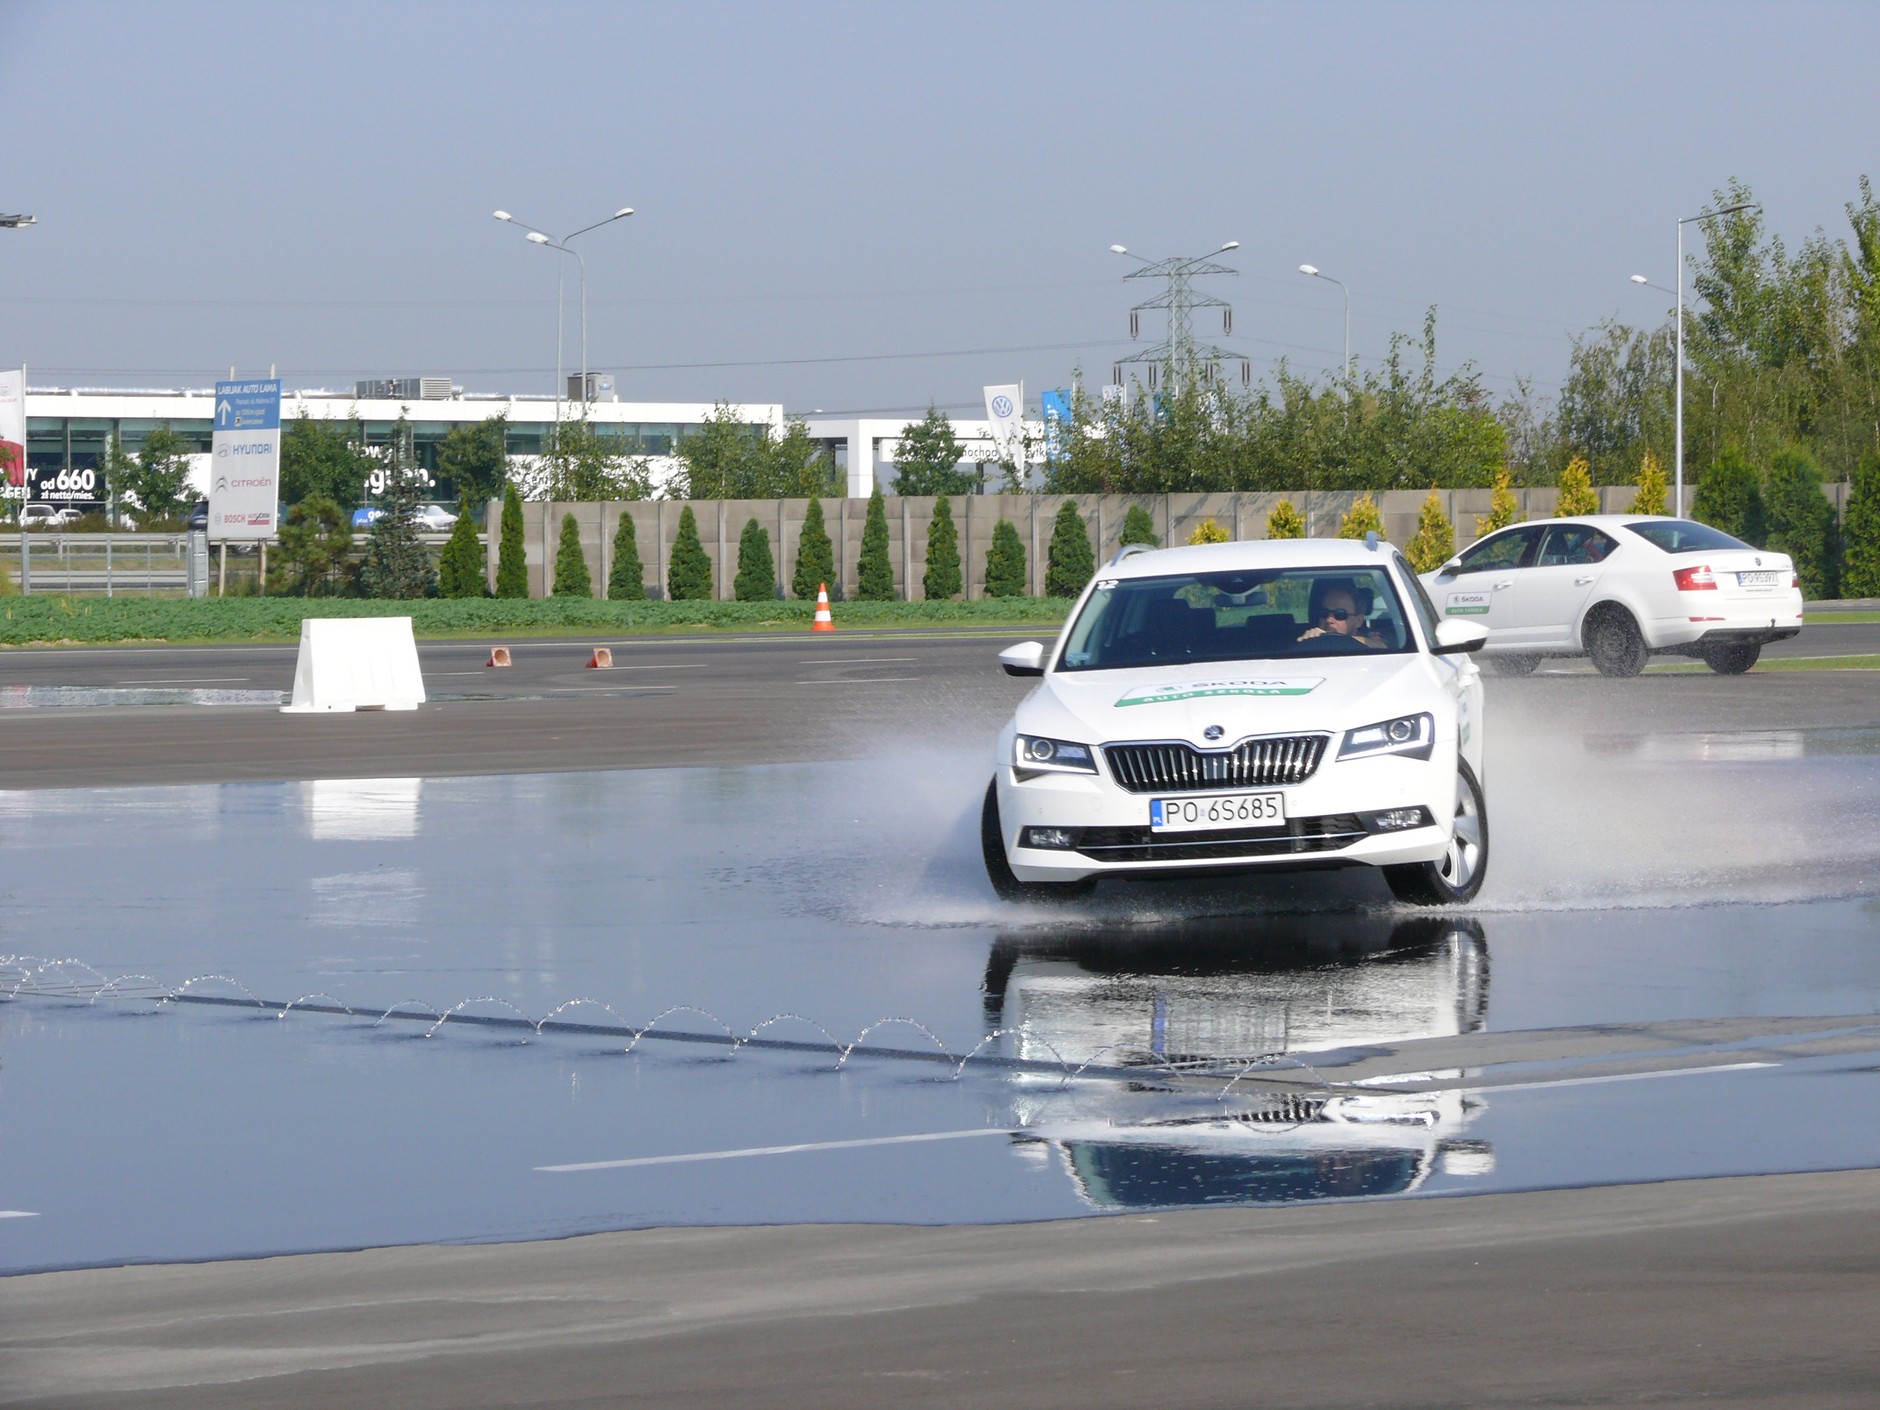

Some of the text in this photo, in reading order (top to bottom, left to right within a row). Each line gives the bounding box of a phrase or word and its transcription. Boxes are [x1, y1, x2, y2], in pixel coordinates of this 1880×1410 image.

[243, 384, 259, 393] AUTO
[232, 443, 272, 455] HYUNDAI
[41, 478, 55, 489] od
[57, 469, 95, 490] 660
[224, 514, 246, 524] BOSCH
[1143, 692, 1195, 703] AUTO
[1166, 797, 1278, 824] PO 6S685
